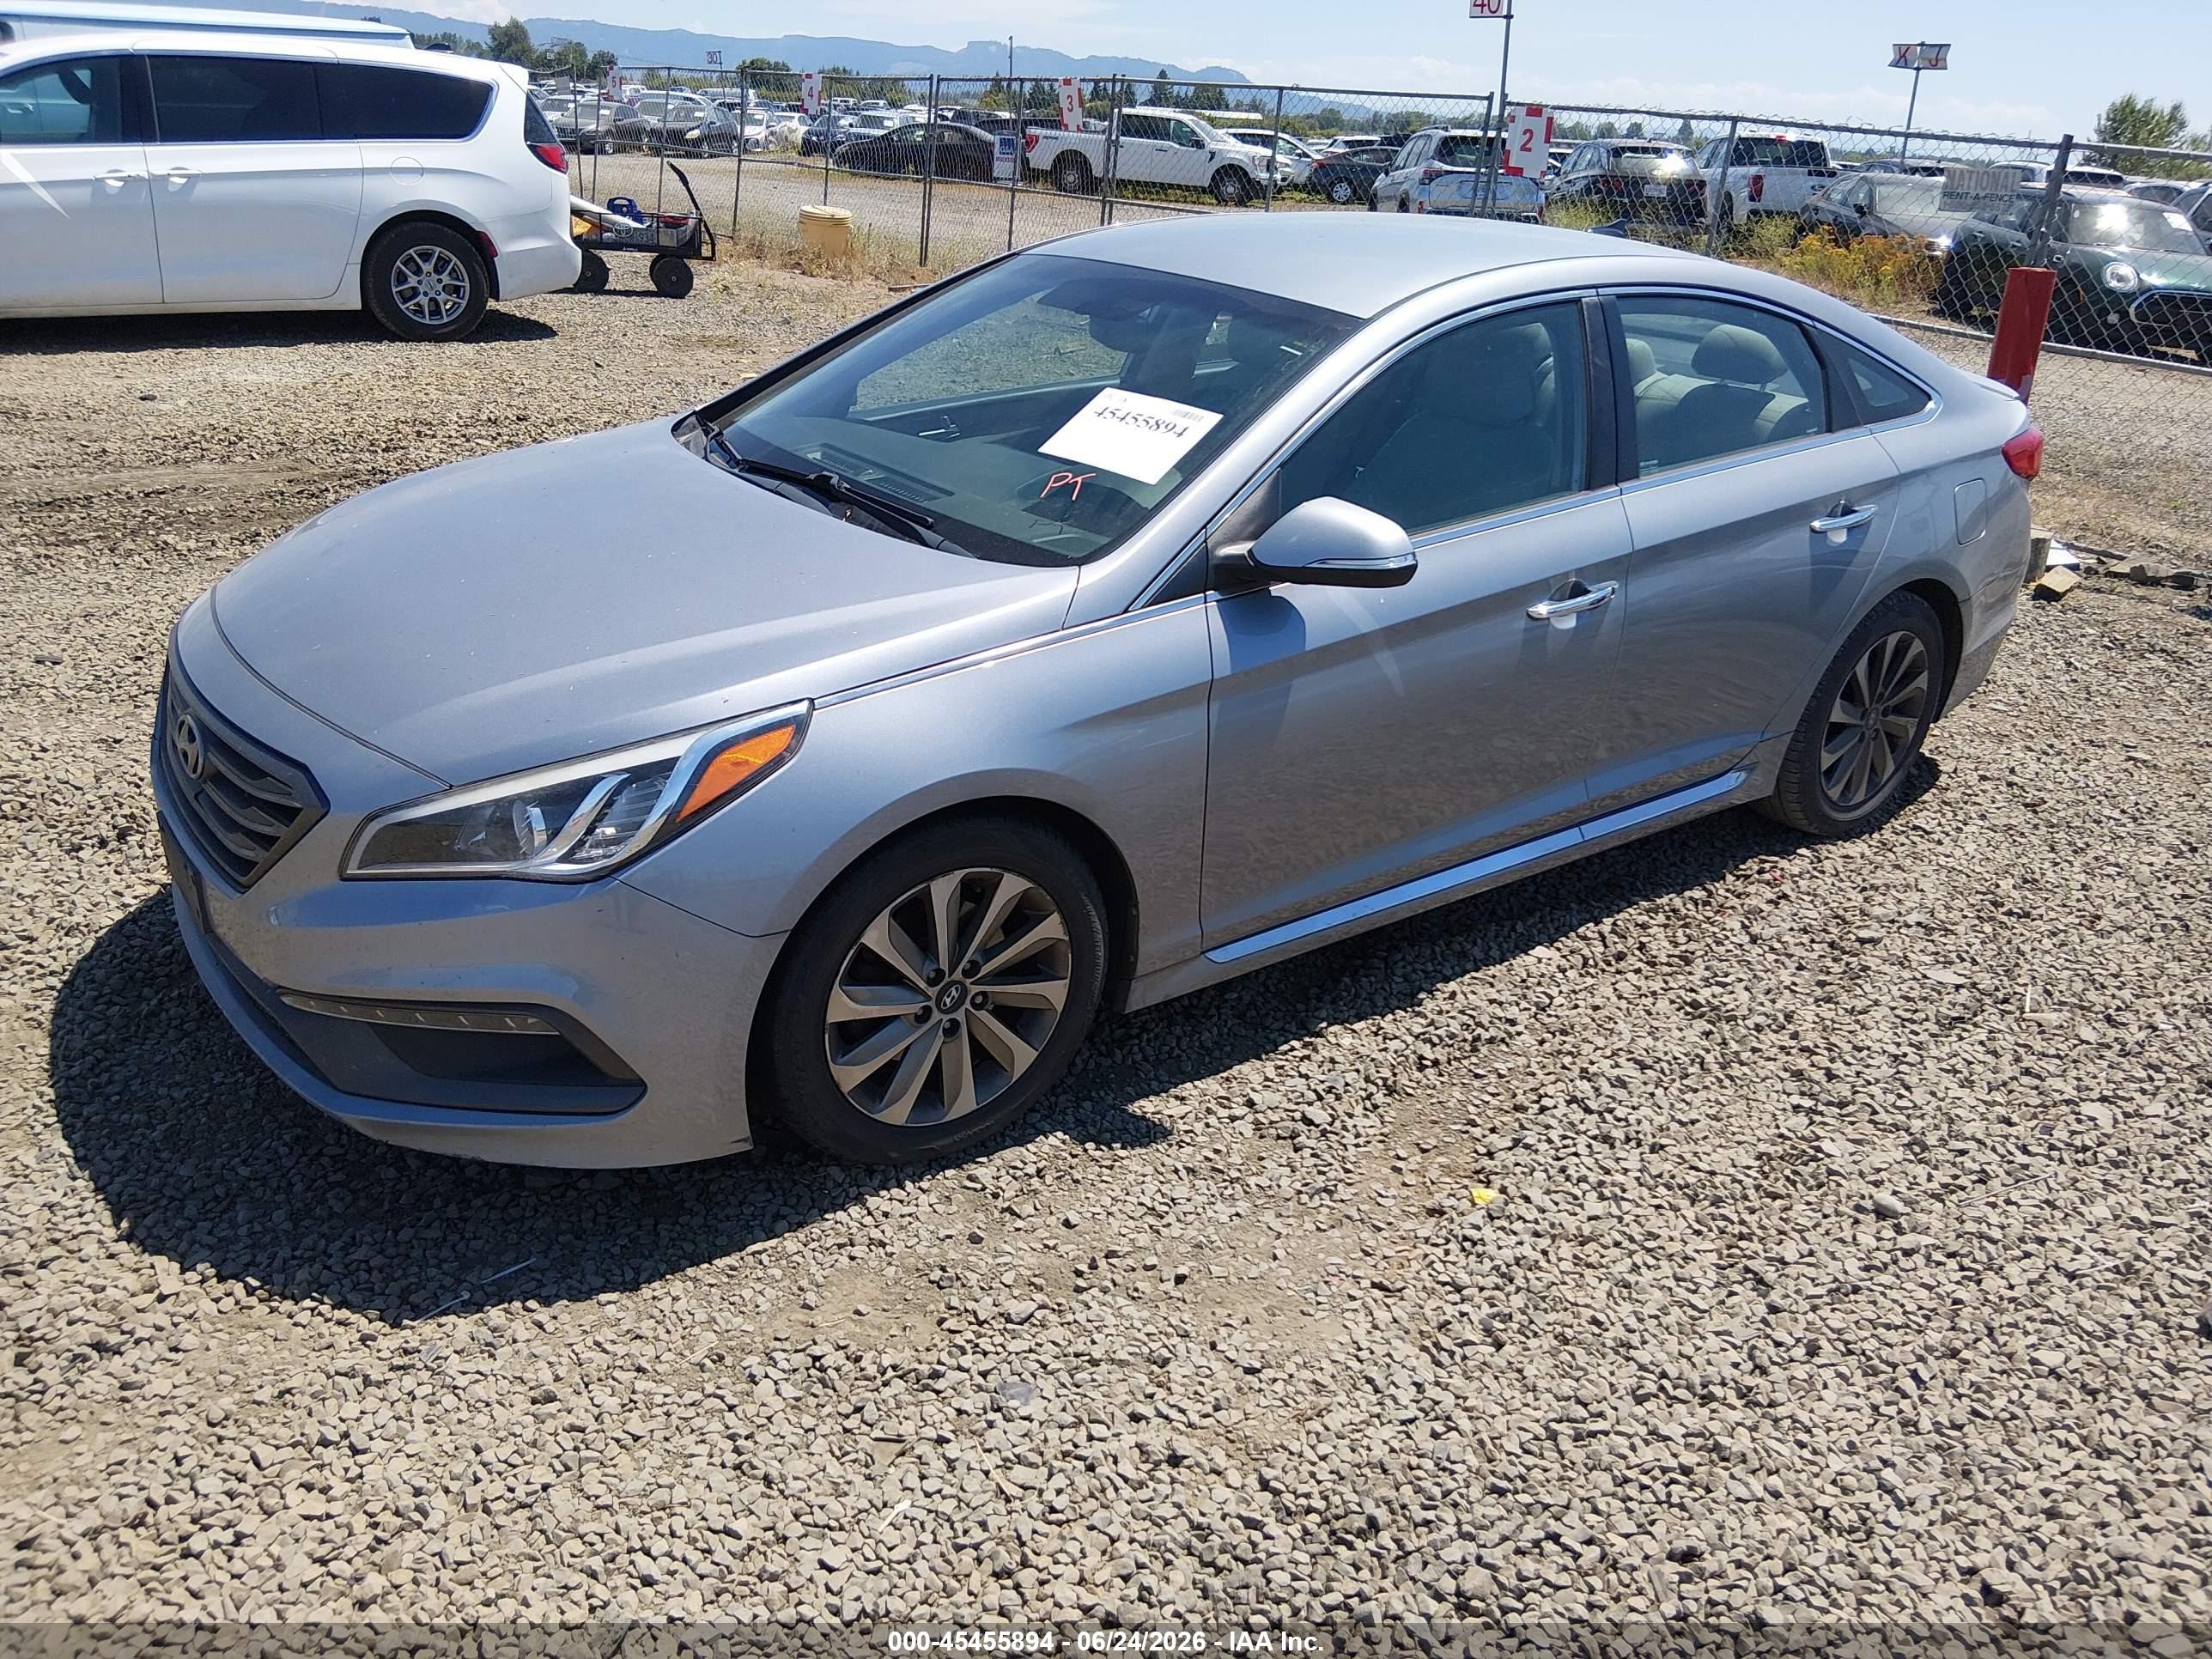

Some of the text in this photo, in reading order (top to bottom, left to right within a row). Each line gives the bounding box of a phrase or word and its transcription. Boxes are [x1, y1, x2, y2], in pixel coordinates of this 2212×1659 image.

[1473, 0, 1501, 14] 40
[708, 52, 717, 64] 30
[1895, 46, 1911, 66] K
[1929, 46, 1942, 67] J
[807, 86, 814, 100] 4
[1066, 94, 1073, 112] 3
[1520, 129, 1534, 152] 2
[1943, 169, 2021, 192] NATIONAL
[1942, 191, 2014, 203] RENT-A-FENCE
[1094, 406, 1189, 438] 45455894
[1040, 472, 1097, 501] PT
